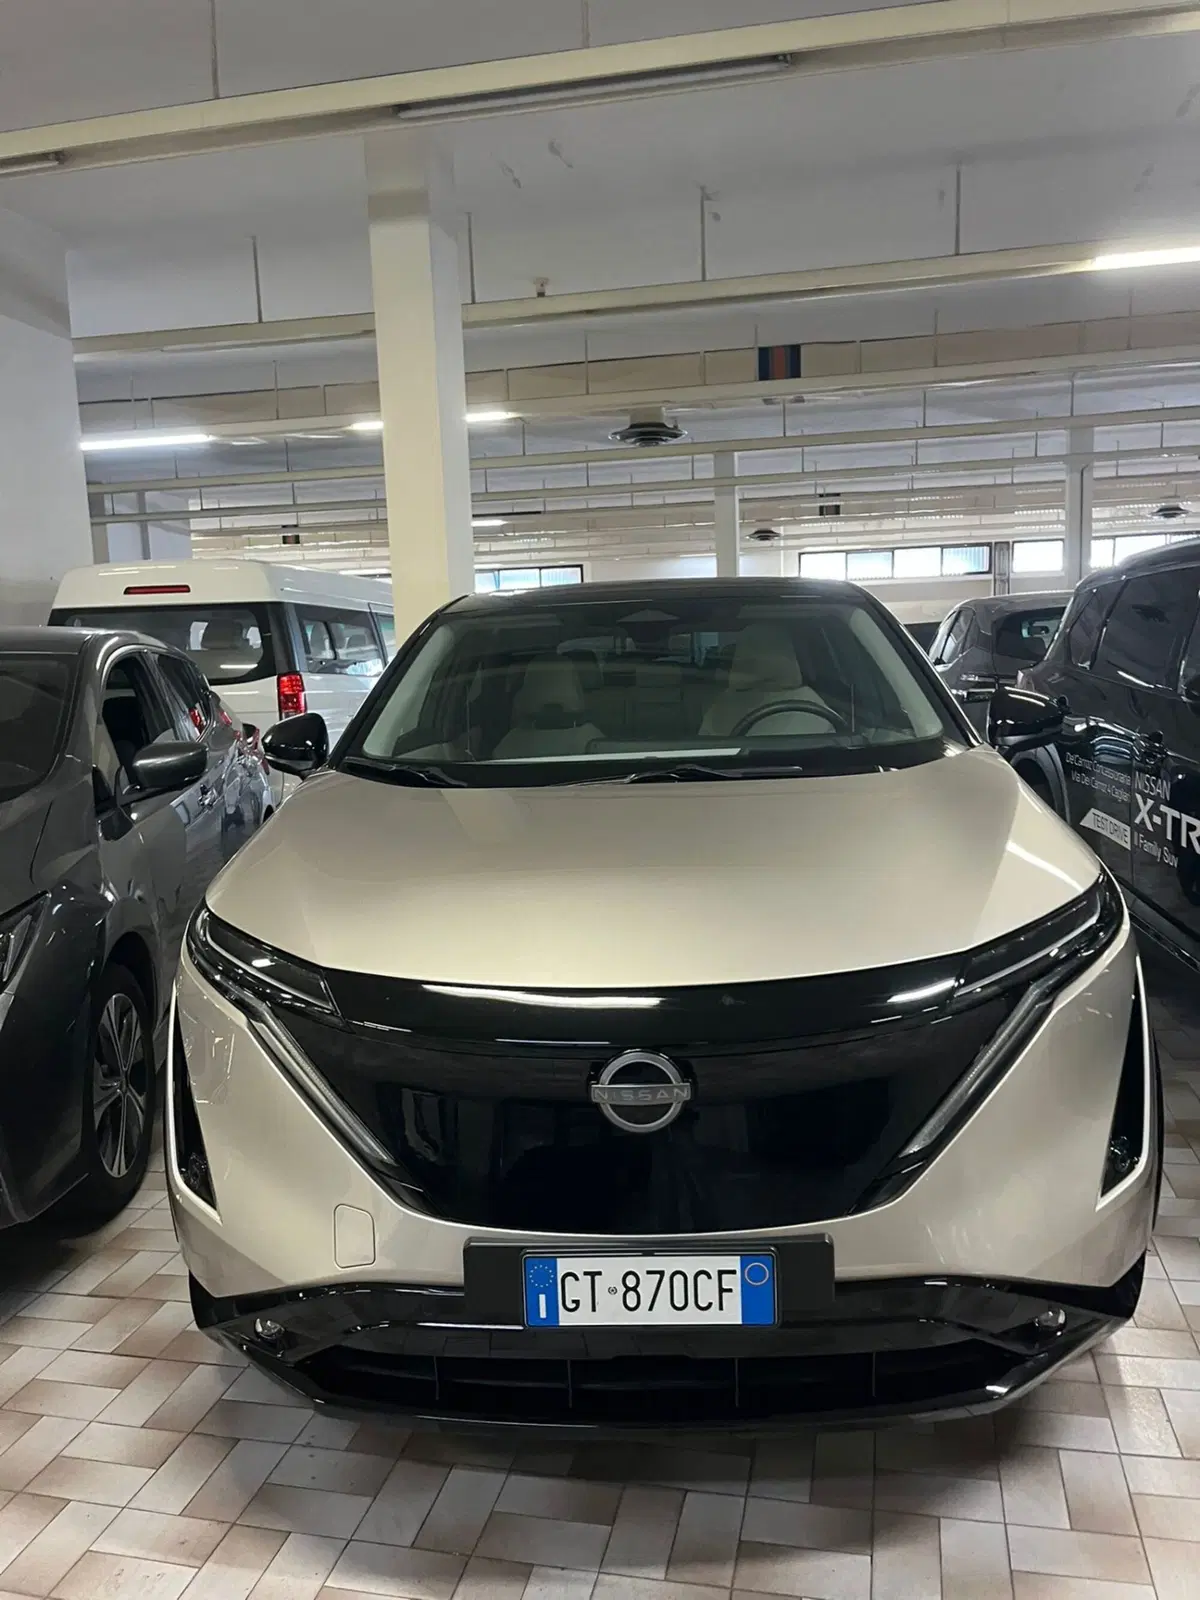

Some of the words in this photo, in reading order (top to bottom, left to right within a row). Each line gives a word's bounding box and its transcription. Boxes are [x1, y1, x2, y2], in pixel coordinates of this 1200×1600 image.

[1135, 771, 1171, 801] NISSAN
[1092, 812, 1108, 832] TEST
[1109, 820, 1128, 844] DRIVE
[1139, 833, 1161, 862] Family
[594, 1087, 688, 1101] NISSAN
